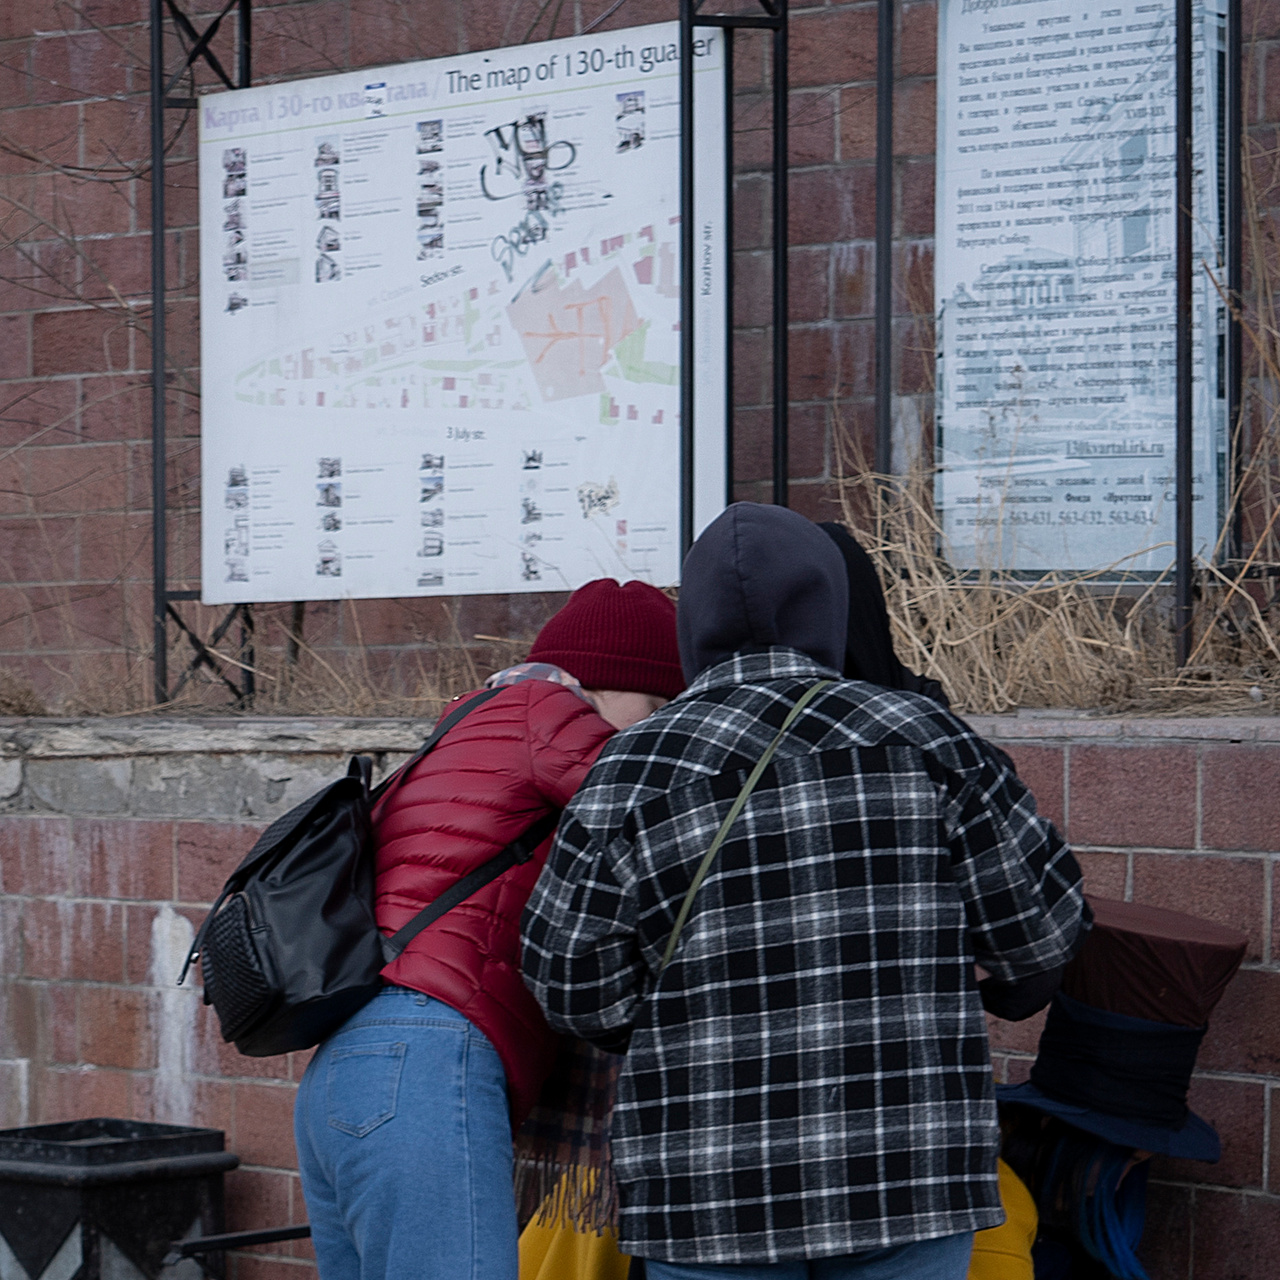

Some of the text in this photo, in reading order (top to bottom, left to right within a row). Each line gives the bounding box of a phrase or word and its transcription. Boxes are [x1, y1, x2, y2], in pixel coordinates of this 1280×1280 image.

[204, 105, 261, 132] Карта
[267, 94, 333, 120] 130-го
[445, 69, 481, 94] The
[486, 65, 531, 91] map
[535, 54, 558, 81] of
[564, 45, 634, 78] 130-th
